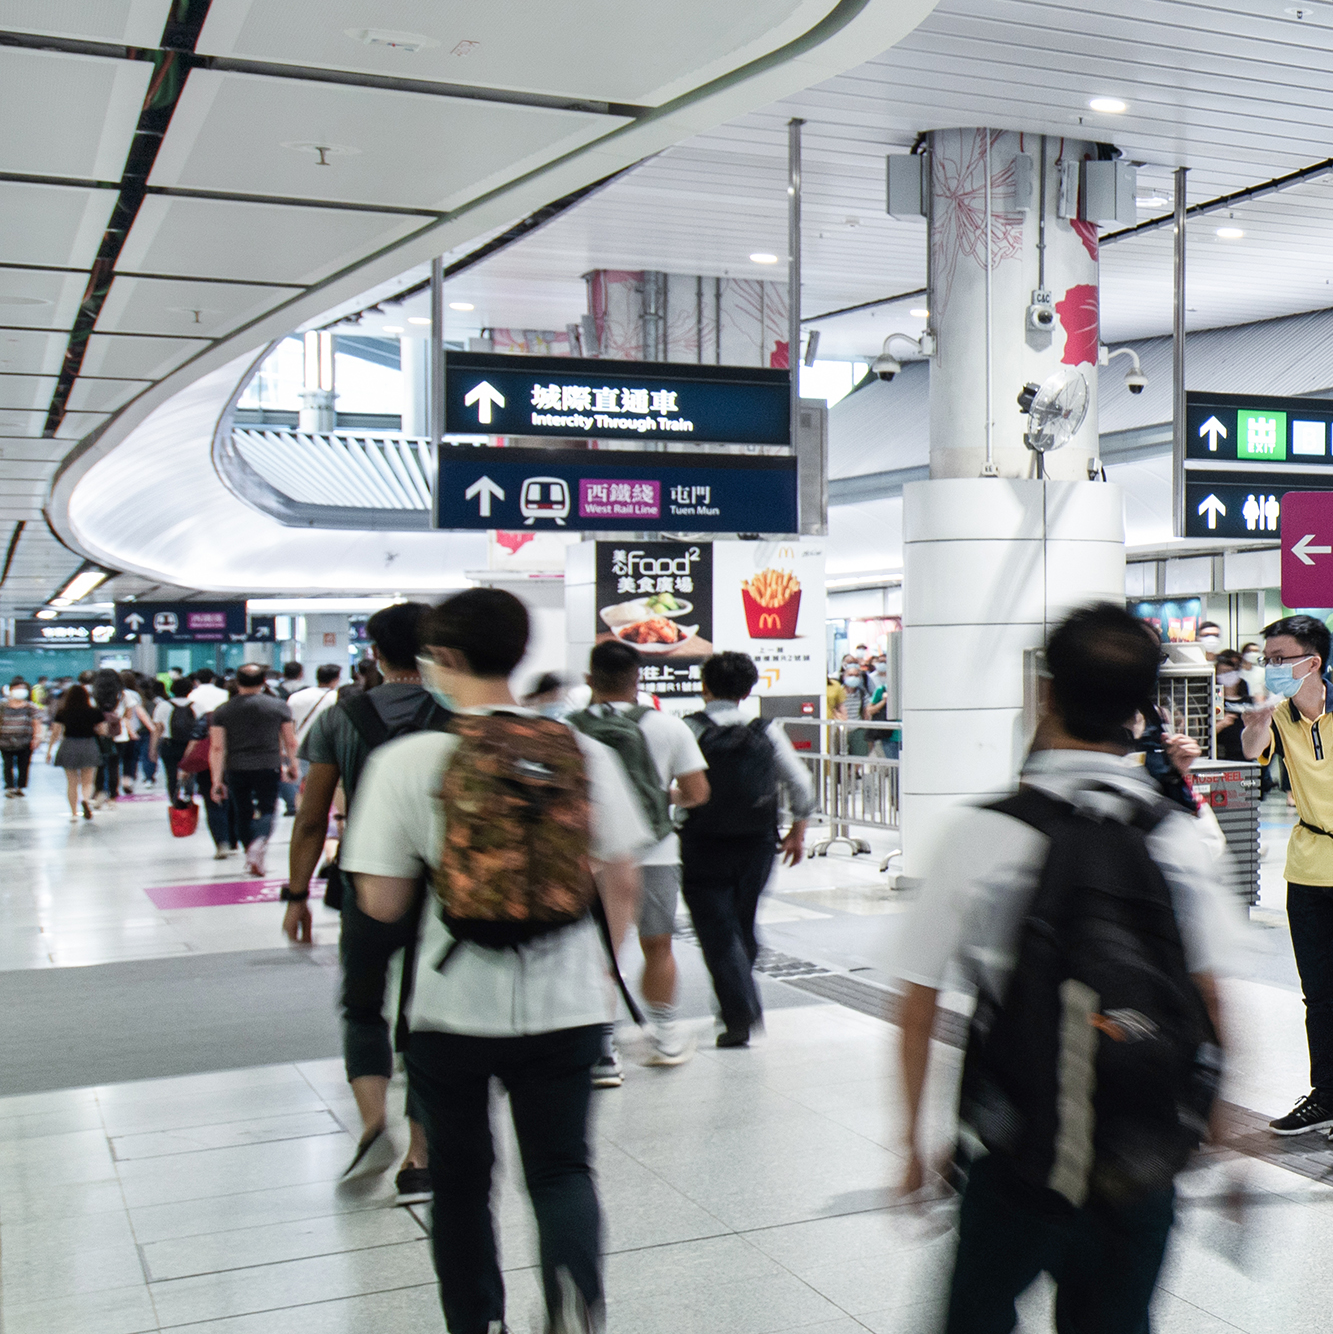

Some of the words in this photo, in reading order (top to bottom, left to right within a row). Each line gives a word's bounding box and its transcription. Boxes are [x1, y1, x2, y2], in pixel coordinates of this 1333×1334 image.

[1037, 293, 1050, 303] C&C
[531, 383, 679, 415] 城際直通車
[531, 412, 594, 431] Intercity
[594, 414, 657, 432] Through
[657, 417, 693, 432] Train
[1302, 427, 1317, 450] B
[1247, 443, 1276, 454] EXIT
[586, 483, 654, 504] 西鐵綫
[670, 484, 711, 505] 屯門
[585, 504, 612, 514] West
[614, 504, 633, 514] Rail
[635, 504, 659, 515] Line
[669, 505, 695, 515] Tuen
[697, 506, 720, 516] Mun
[617, 576, 694, 594] 美食廣場
[1221, 771, 1245, 783] REEL
